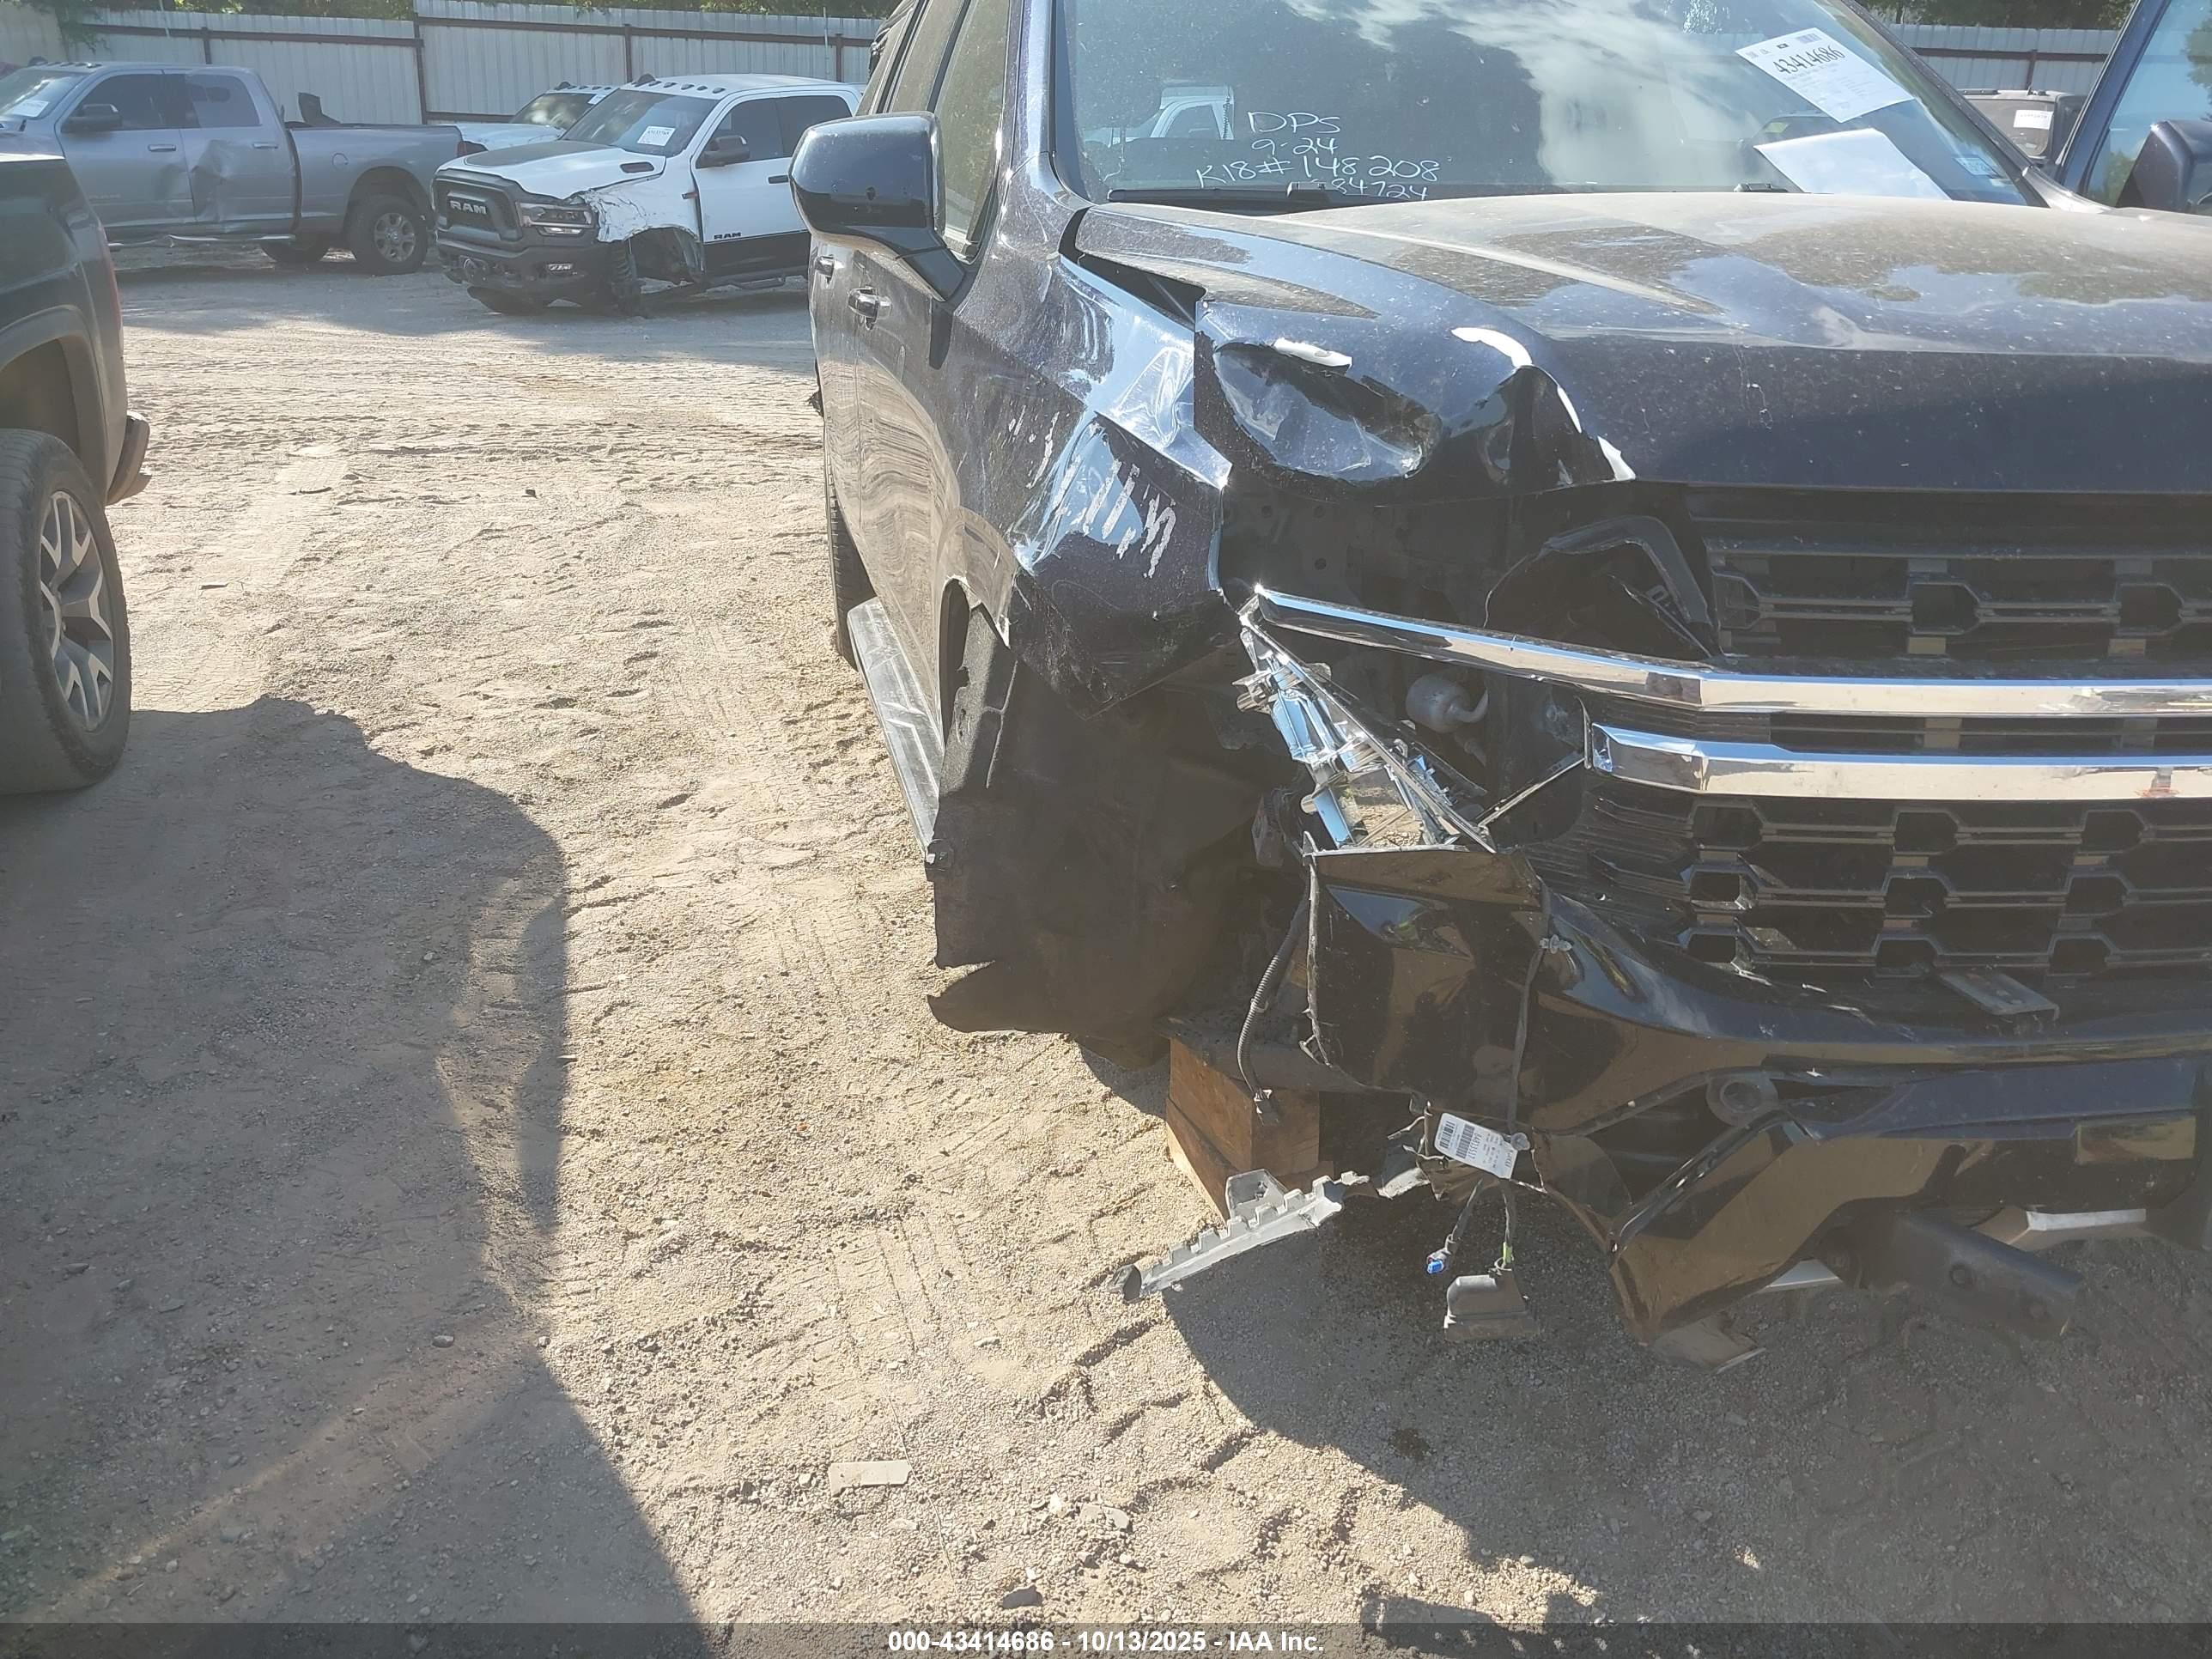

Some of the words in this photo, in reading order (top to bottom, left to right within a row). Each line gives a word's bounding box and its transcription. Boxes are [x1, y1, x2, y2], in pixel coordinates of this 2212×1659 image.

[1772, 46, 1845, 74] 43414686
[1248, 112, 1340, 133] DPS
[1251, 137, 1339, 155] 9-24
[450, 200, 487, 214] RAM
